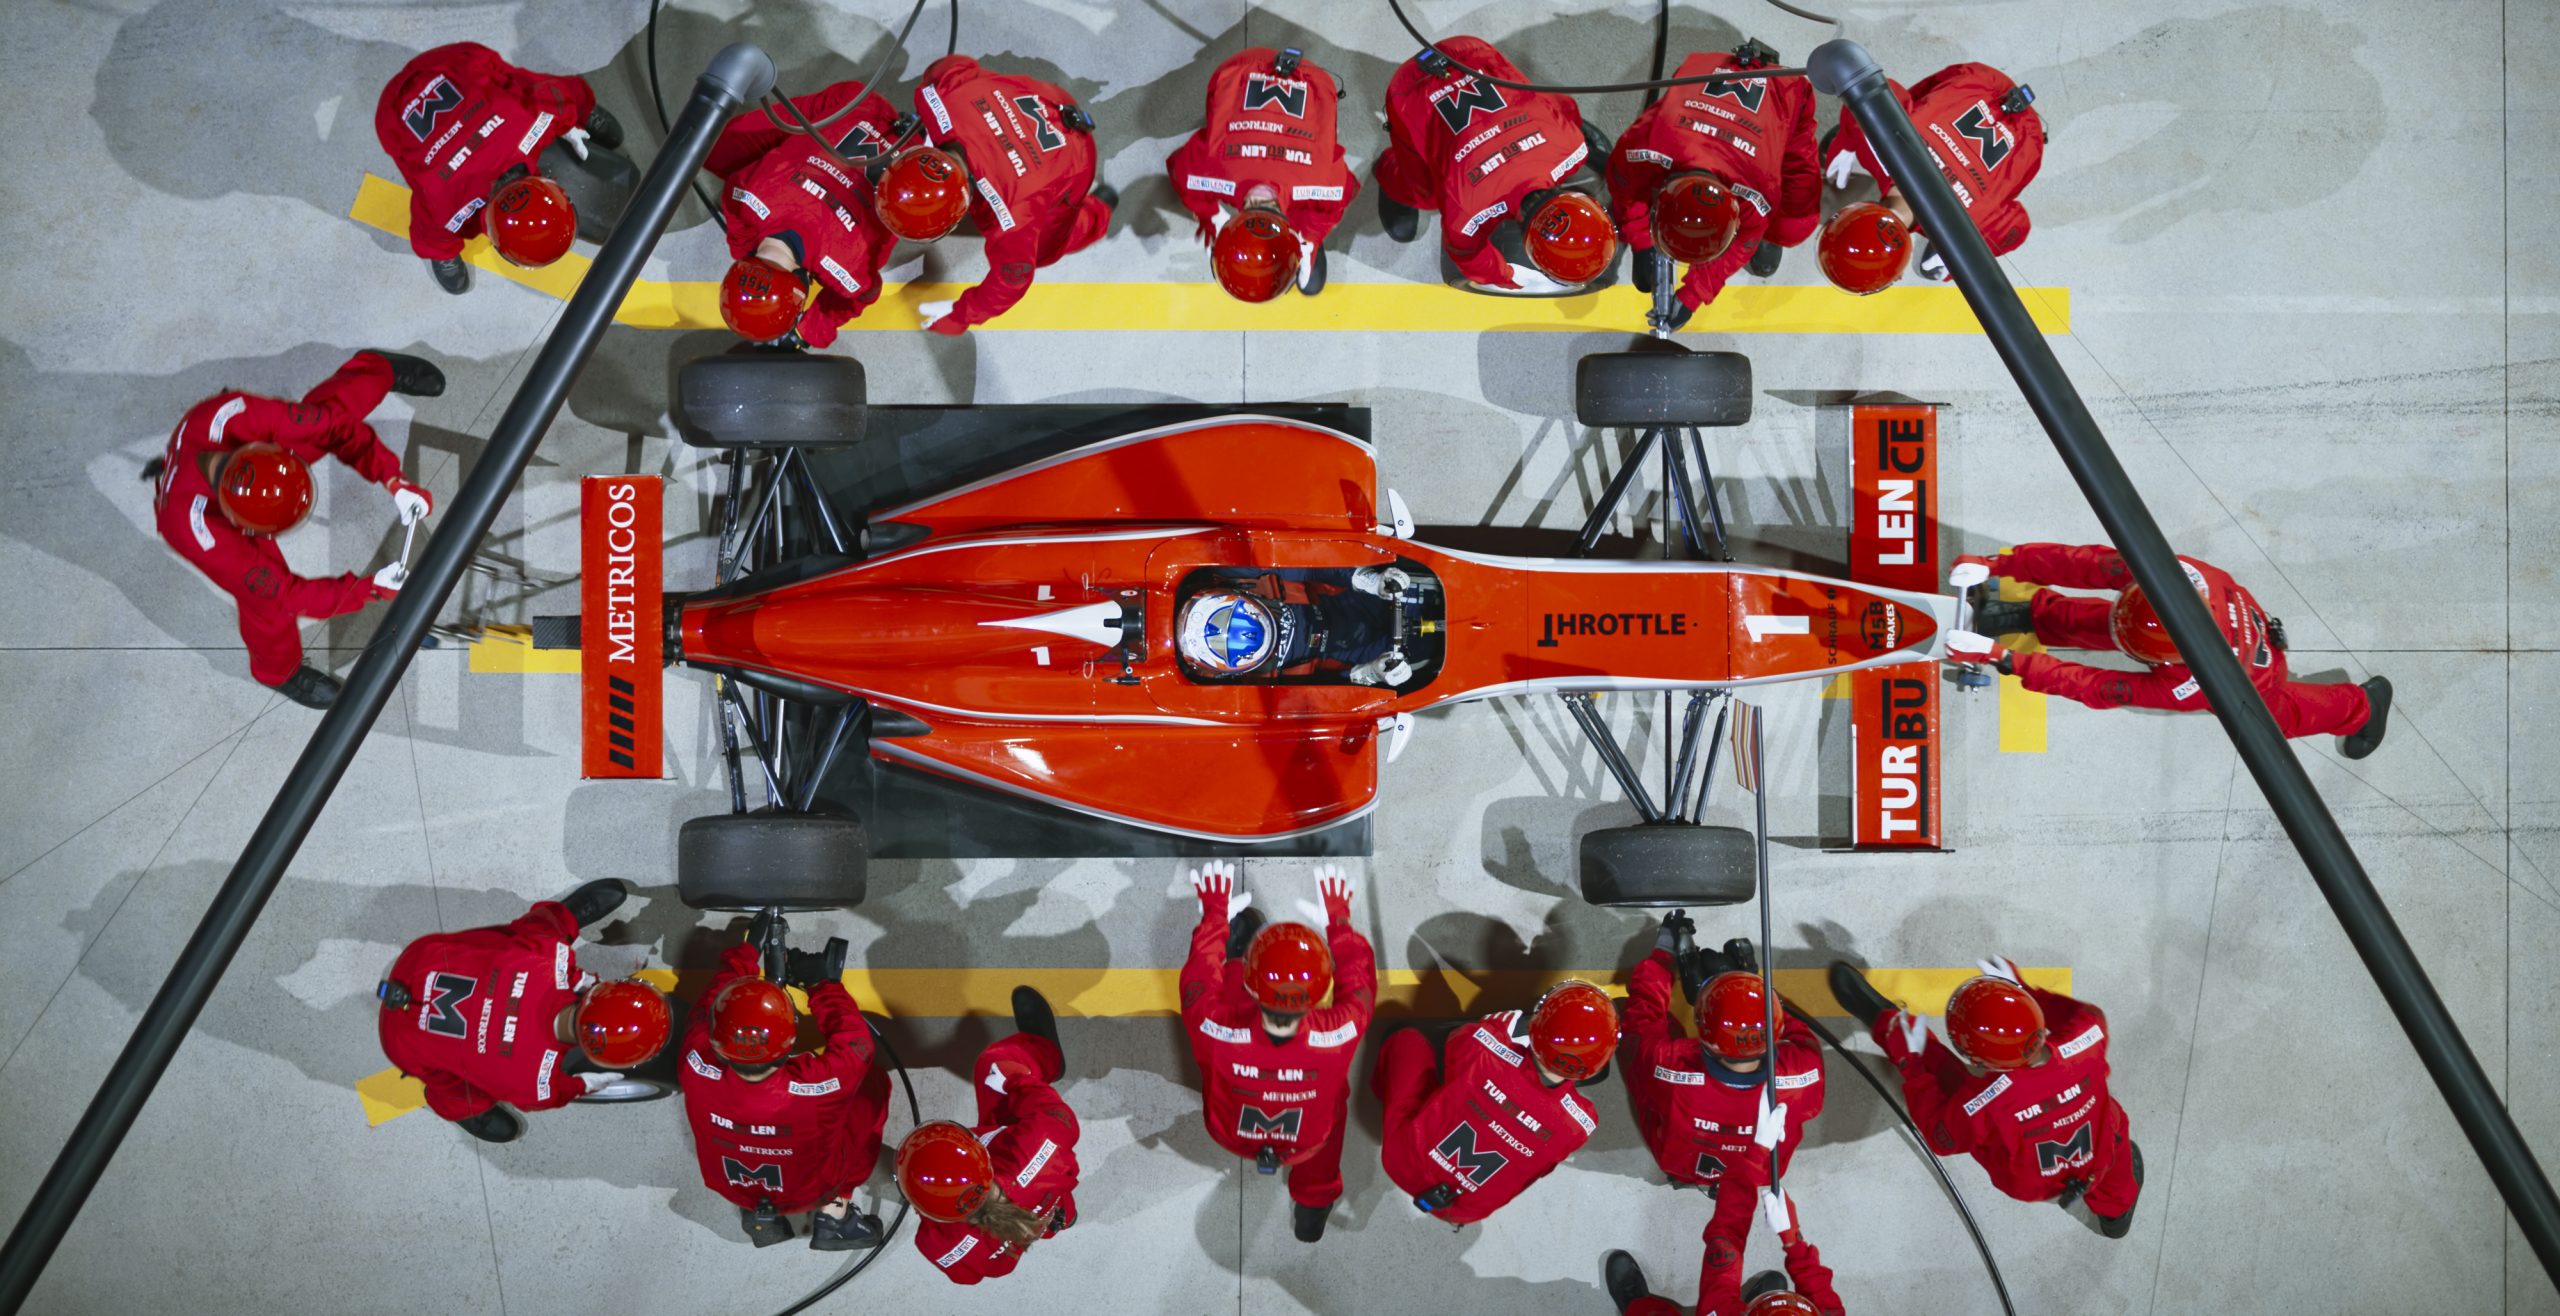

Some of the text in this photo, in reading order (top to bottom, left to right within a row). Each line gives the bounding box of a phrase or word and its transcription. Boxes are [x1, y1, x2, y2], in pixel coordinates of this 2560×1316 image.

[992, 90, 1027, 139] METRICOS
[1229, 120, 1283, 133] METRICOS
[1684, 100, 1736, 121] METRICOS
[424, 121, 463, 164] METRICOS
[1455, 125, 1501, 163] METRICOS
[1928, 122, 1970, 167] METRICOS
[807, 156, 853, 188] METRICOS
[608, 484, 636, 664] METRICOS
[1745, 615, 1810, 643] 1
[1885, 603, 1896, 649] BRAKES
[477, 998, 493, 1054] METRICOS
[2053, 1095, 2097, 1129] METRICOS
[739, 1144, 793, 1156] METRICOS
[1436, 1120, 1509, 1187] M
[1488, 1120, 1534, 1157] METRICOS
[1455, 1170, 1478, 1192] SPEED
